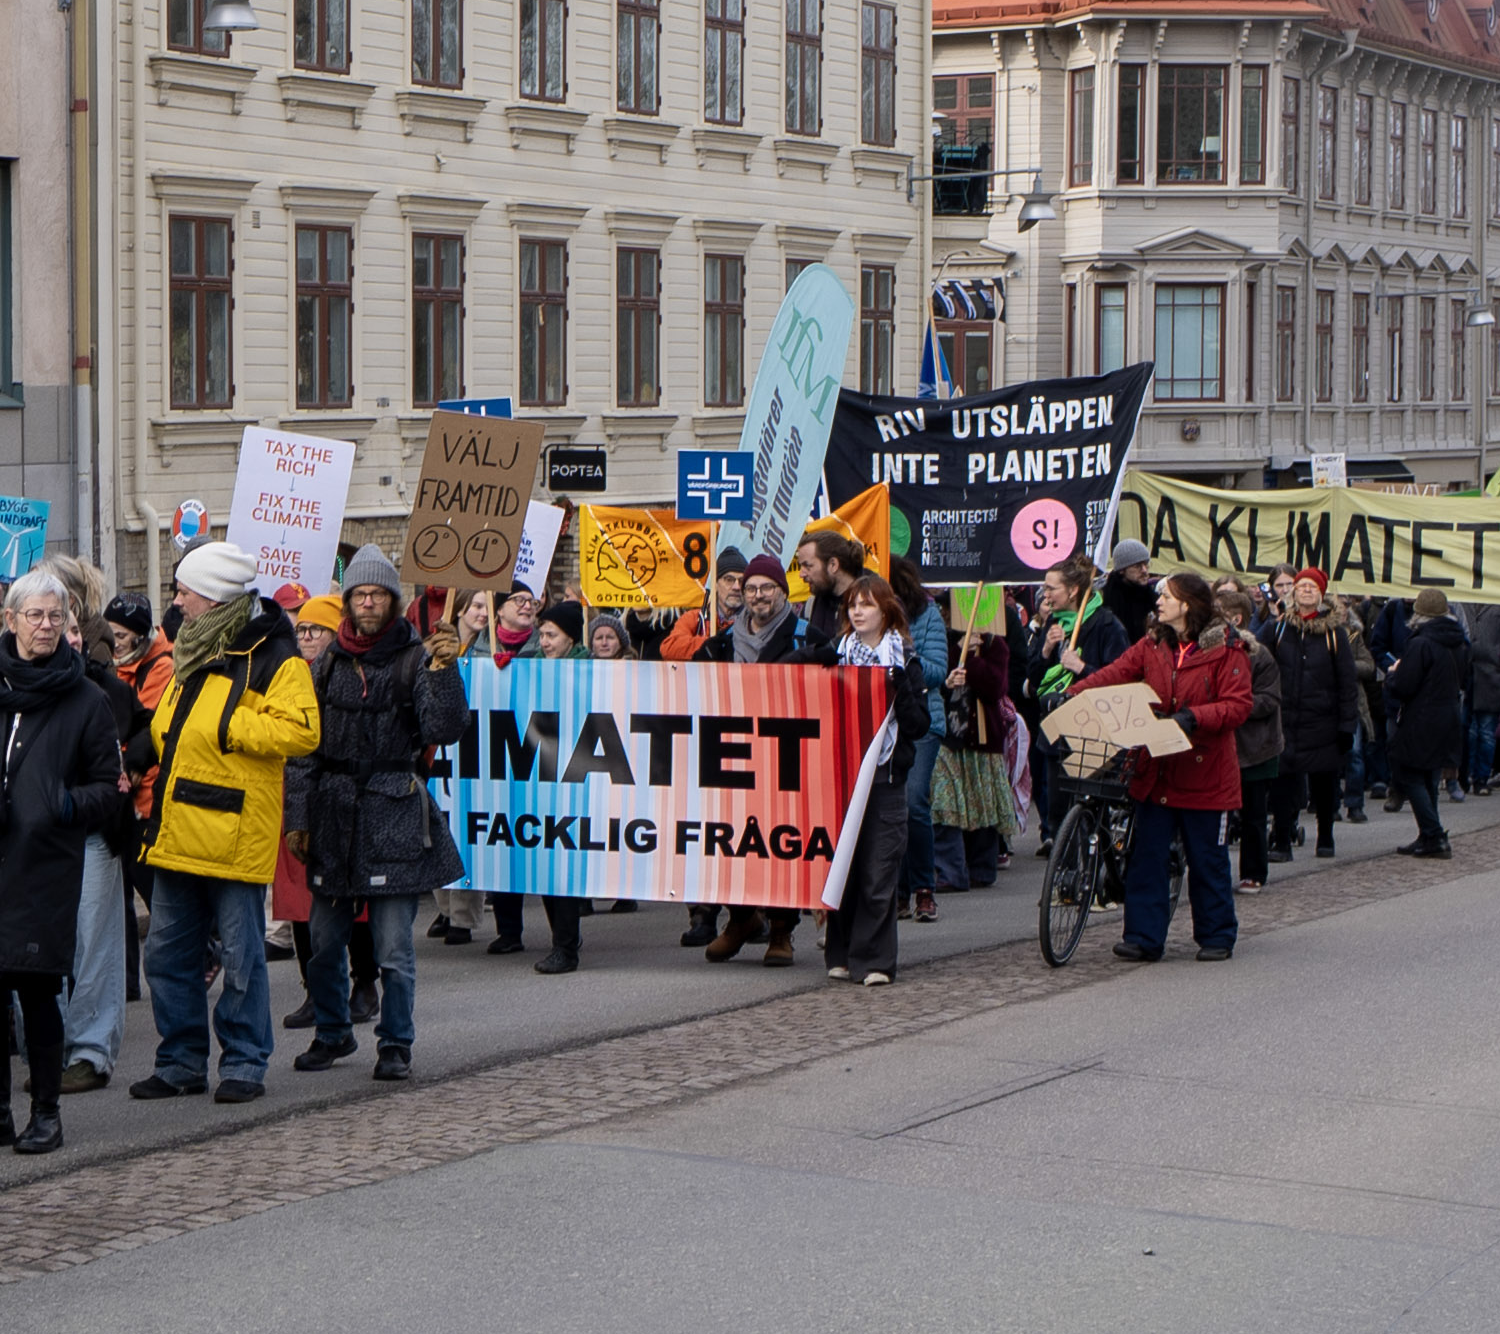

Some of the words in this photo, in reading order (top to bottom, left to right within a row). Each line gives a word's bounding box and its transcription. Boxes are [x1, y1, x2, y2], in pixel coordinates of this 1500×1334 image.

[874, 407, 926, 443] RIV
[952, 395, 1114, 439] UTSLÄPPEN
[265, 439, 297, 457] TAX
[302, 445, 334, 464] THE
[442, 428, 521, 470] VÄLJ
[276, 457, 316, 477] RICH
[551, 464, 604, 477] POPTEA
[872, 452, 940, 485] INTE
[968, 442, 1111, 484] PLANETEN
[772, 424, 803, 532] miljön
[0, 499, 30, 514] BYGG
[258, 492, 284, 509] FIX
[290, 497, 322, 515] THE
[417, 478, 520, 517] FRAMTID
[251, 507, 323, 531] CLIMATE
[921, 507, 998, 524] ARCHITECTS!
[922, 524, 977, 538] CLIMATE
[1032, 519, 1060, 550] S!
[260, 546, 303, 564] SAVE
[683, 532, 708, 579] 8
[922, 538, 968, 552] ACTION
[256, 560, 301, 580] LIVES
[921, 551, 982, 566] NETWORK
[466, 811, 658, 855] FACKLIG
[675, 815, 834, 863] FRÅGA
